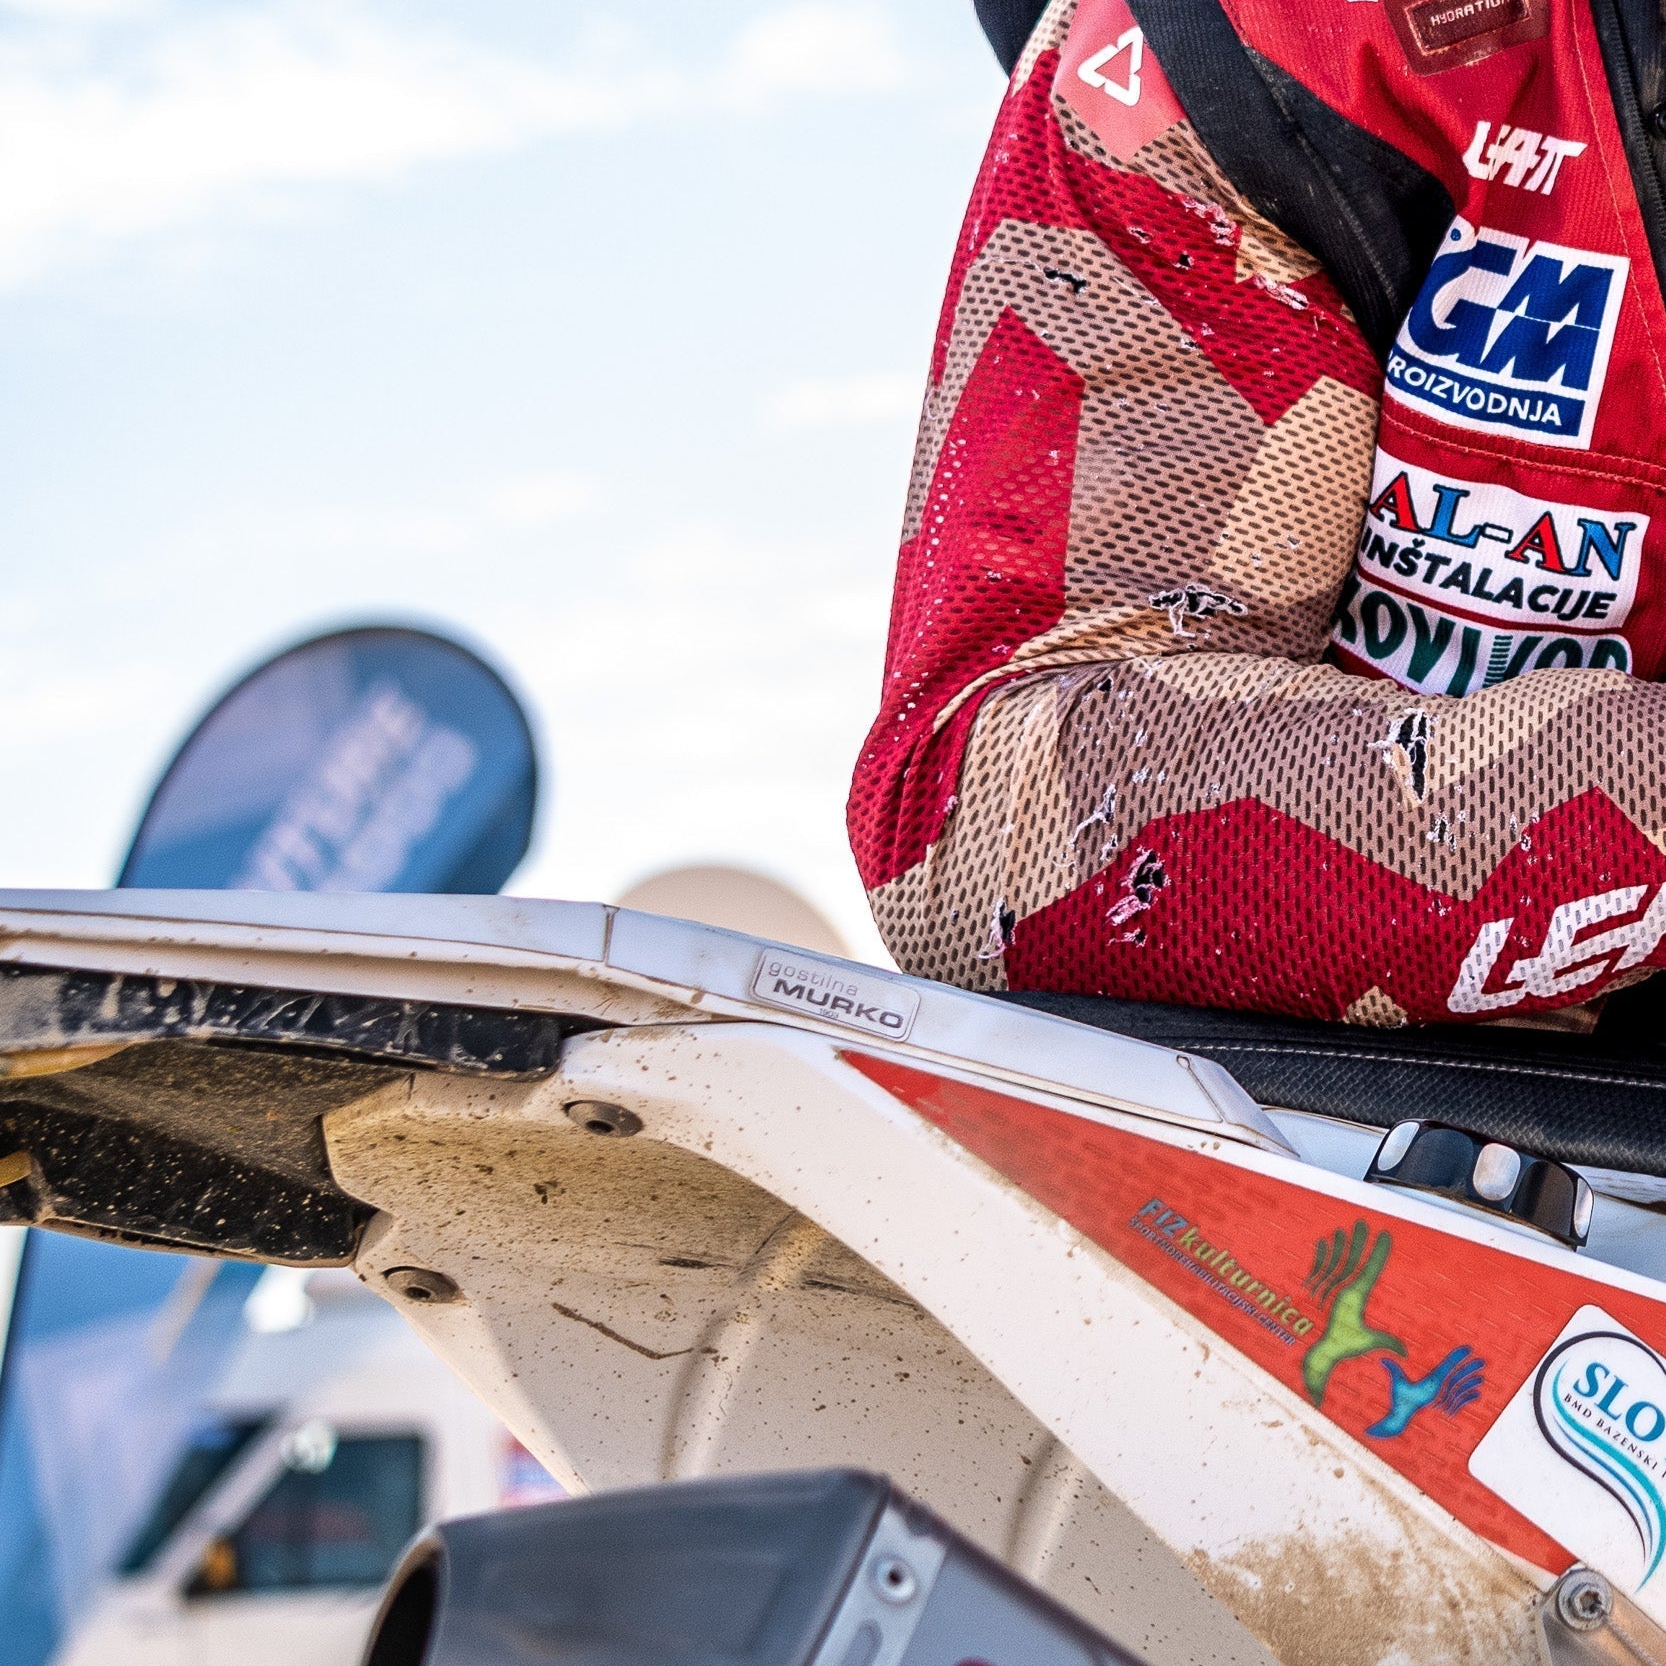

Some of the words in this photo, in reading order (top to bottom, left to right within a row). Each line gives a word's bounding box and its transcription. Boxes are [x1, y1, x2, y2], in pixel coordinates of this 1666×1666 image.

[1388, 349, 1562, 426] ROIZVODNJA
[1370, 471, 1637, 581] AL-AN
[769, 961, 858, 996] gostilna
[773, 978, 904, 1029] MURKO
[1564, 1393, 1593, 1419] BMD
[1573, 1362, 1666, 1443] SLO
